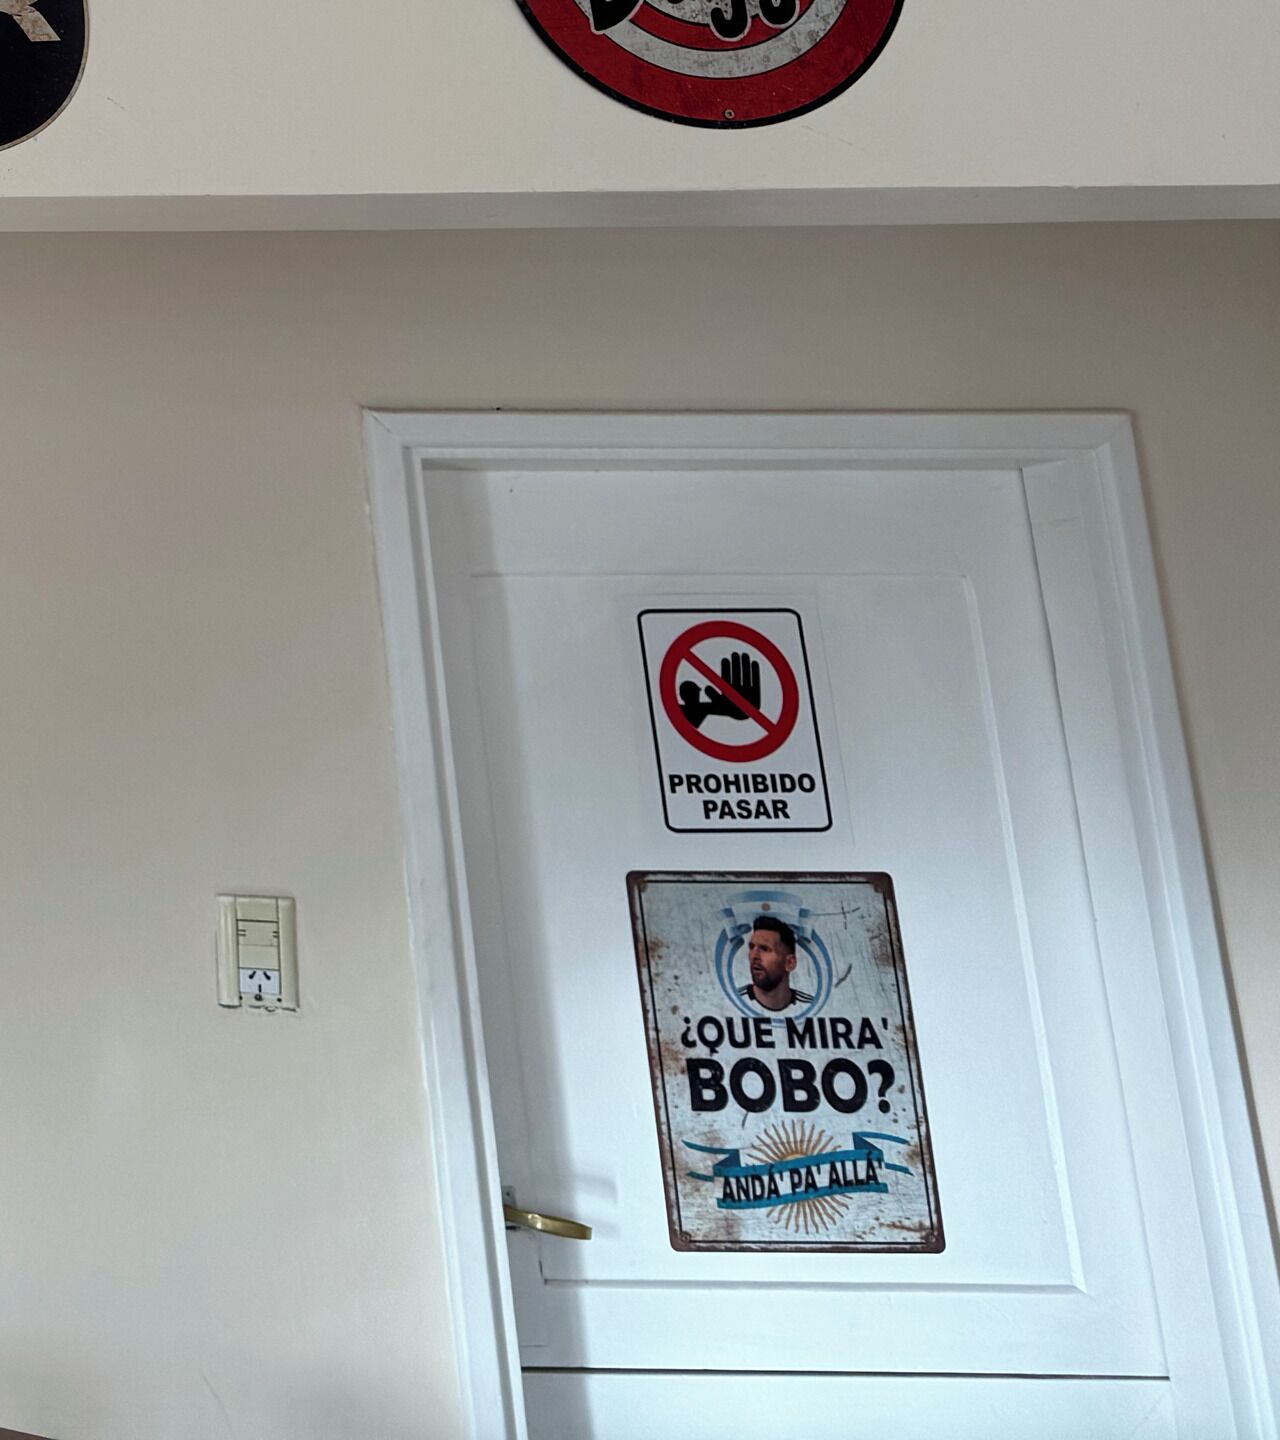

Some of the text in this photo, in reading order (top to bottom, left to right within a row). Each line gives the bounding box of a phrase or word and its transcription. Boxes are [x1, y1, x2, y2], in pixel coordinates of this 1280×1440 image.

[668, 772, 817, 795] PROHIBIDO
[702, 799, 791, 820] PASAR
[680, 1015, 889, 1057] ¿QUE MIRA'
[684, 1056, 896, 1115] BOBO?
[789, 1163, 822, 1196] PA'
